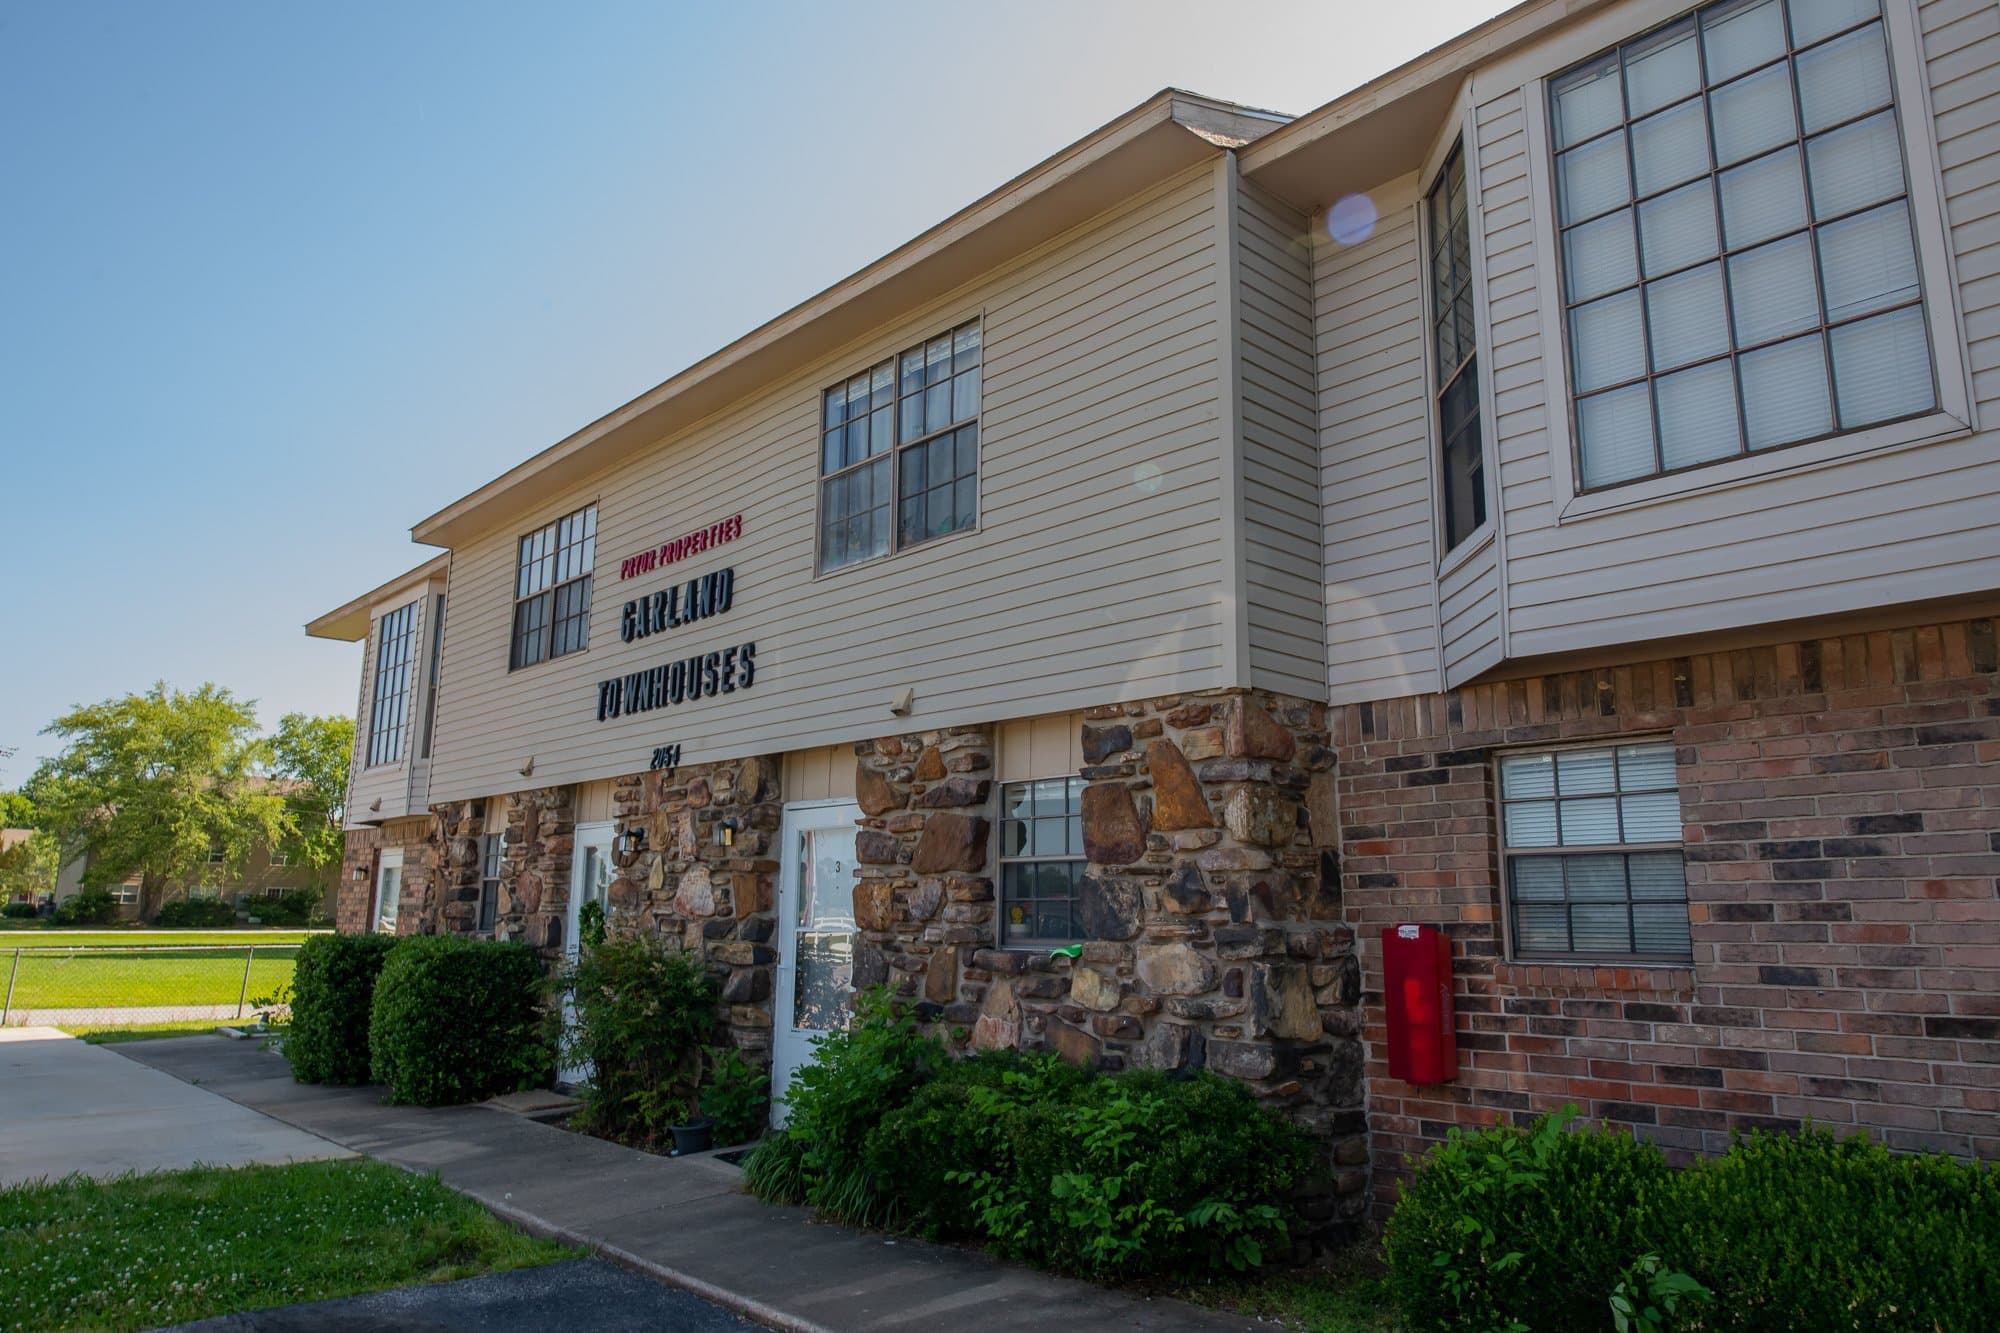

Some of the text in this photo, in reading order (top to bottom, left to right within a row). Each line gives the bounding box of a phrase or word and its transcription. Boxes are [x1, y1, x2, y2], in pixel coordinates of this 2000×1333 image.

[621, 514, 743, 580] PRYOR PROPERTIES
[620, 567, 734, 643] GARLAND
[596, 641, 756, 722] TOWNHOUSES
[835, 860, 841, 873] 3
